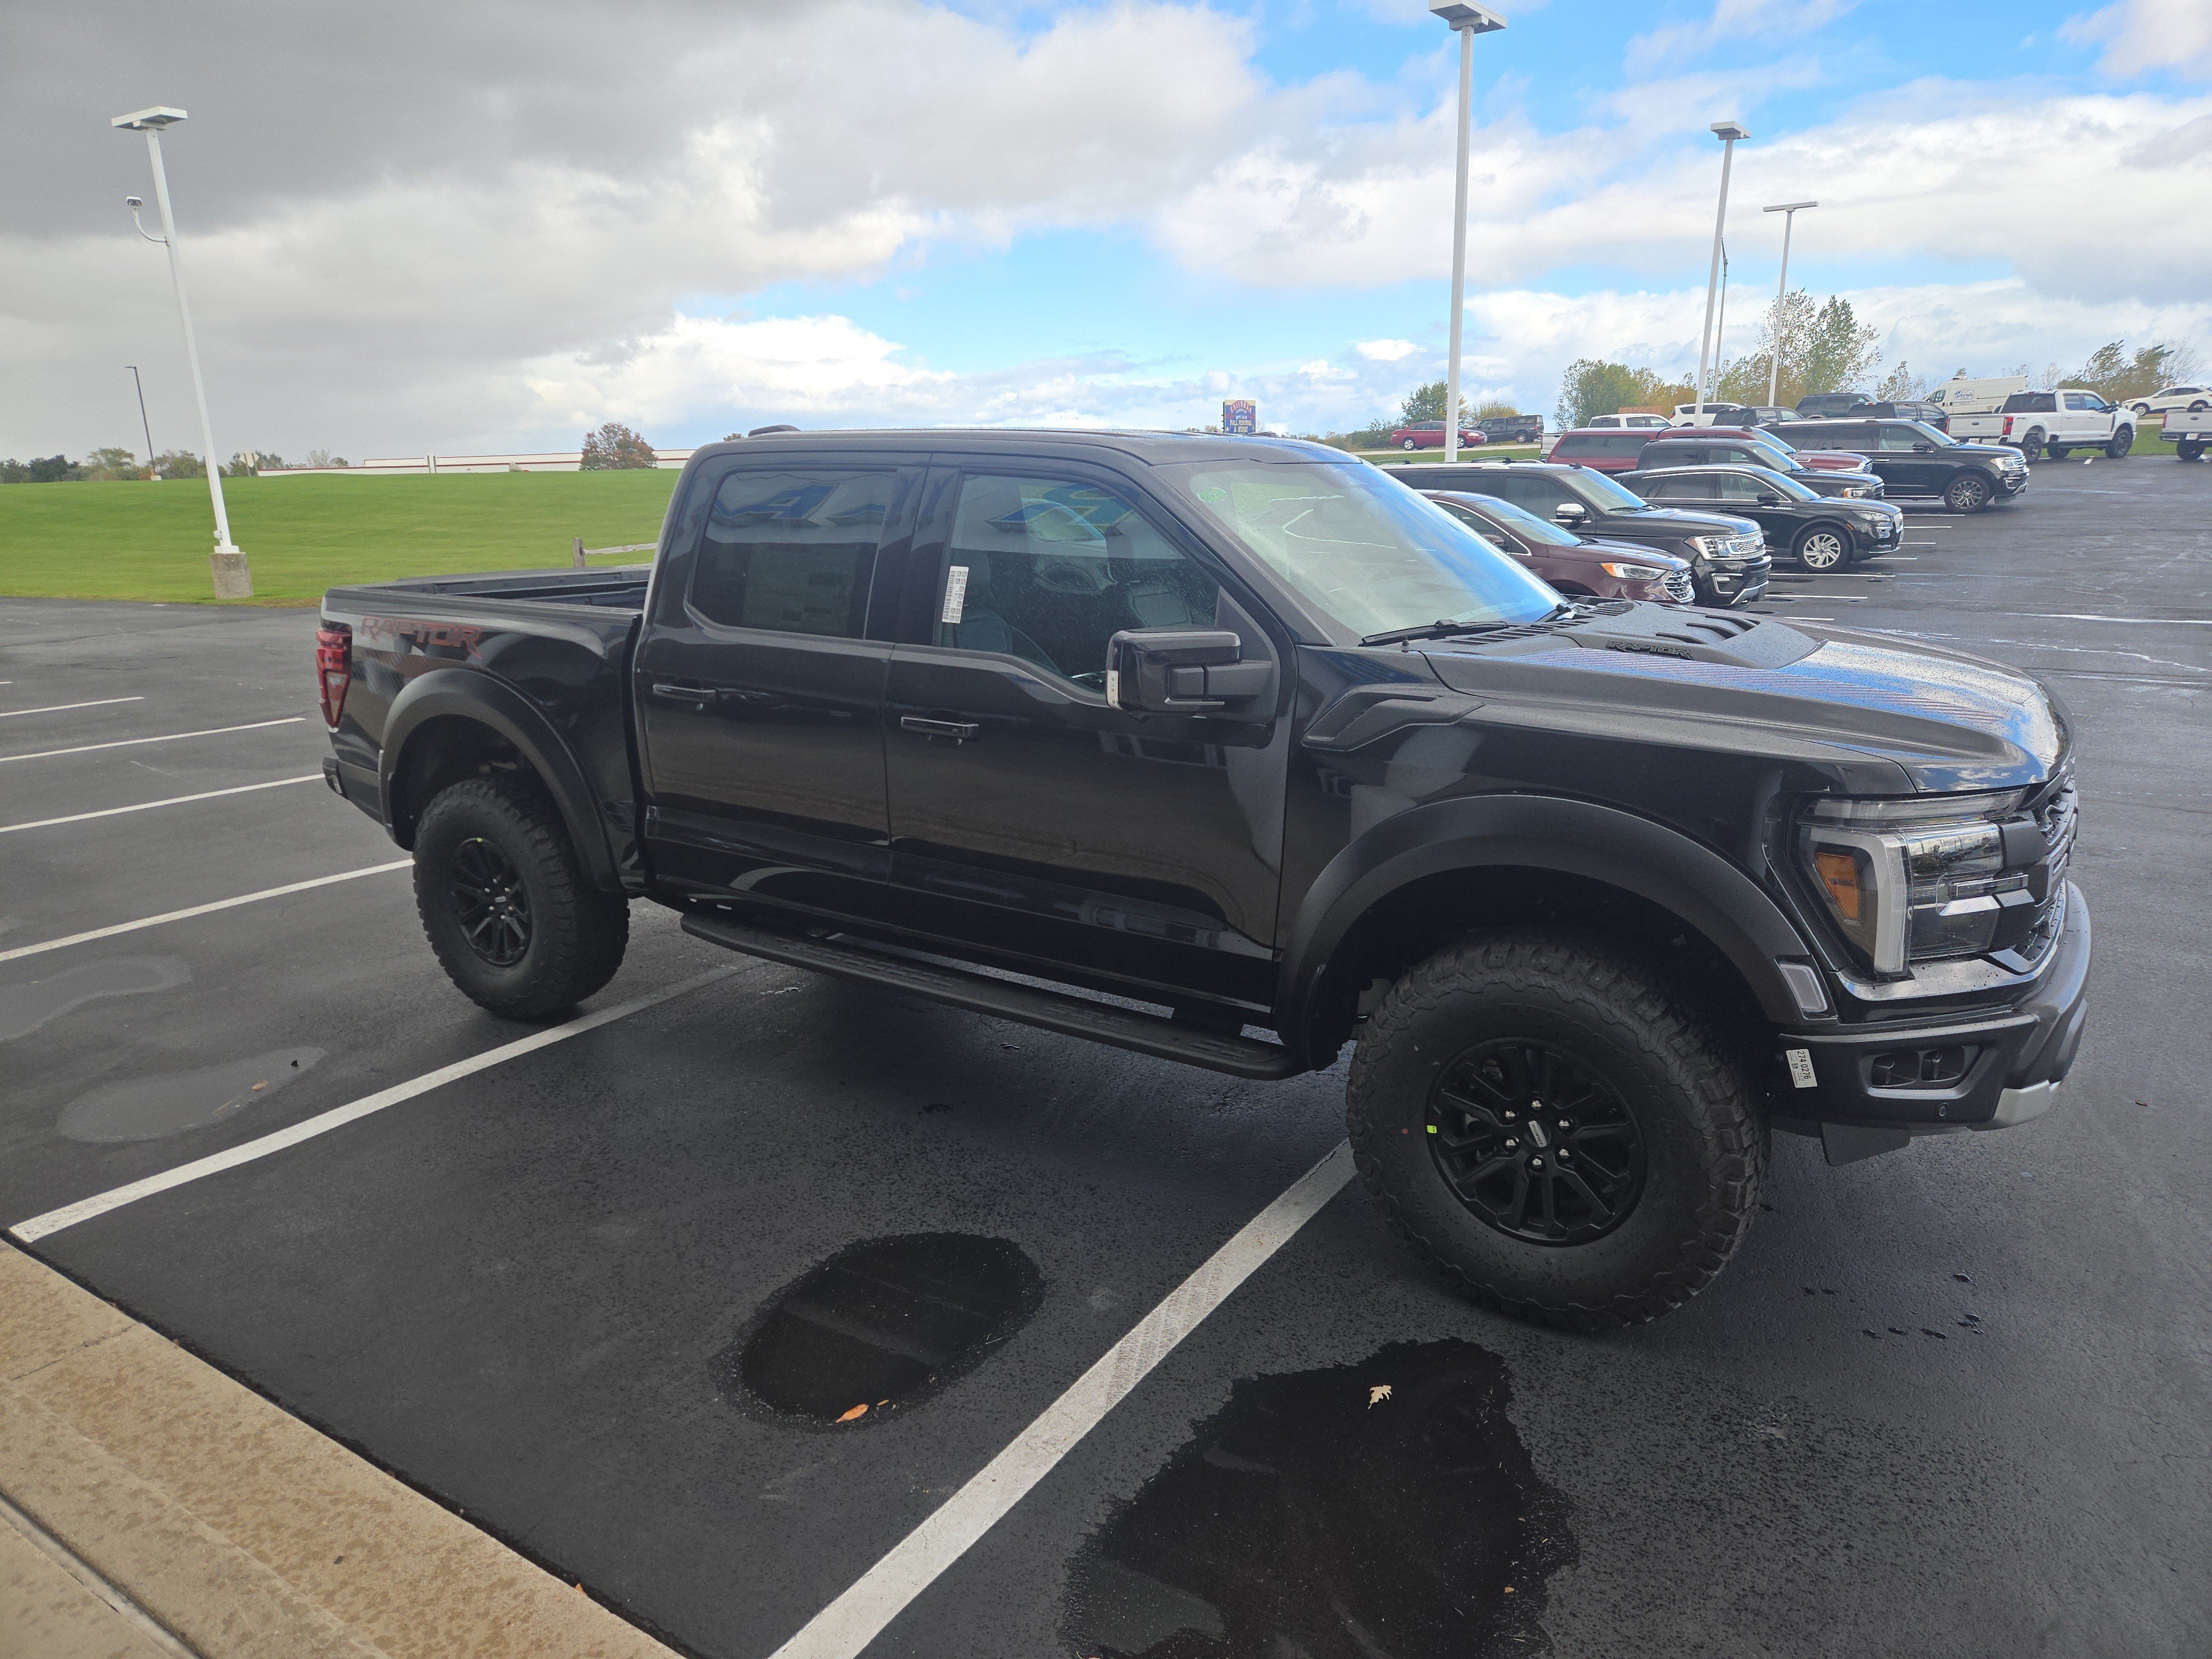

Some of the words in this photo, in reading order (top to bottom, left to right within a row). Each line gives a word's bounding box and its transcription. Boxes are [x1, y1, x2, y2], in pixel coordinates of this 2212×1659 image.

[360, 615, 483, 659] RAPTOR
[1606, 640, 1694, 660] RAPTOR
[1797, 1051, 1806, 1062] 274
[1801, 1064, 1811, 1079] 0276
[1532, 1124, 1543, 1145] FORD
